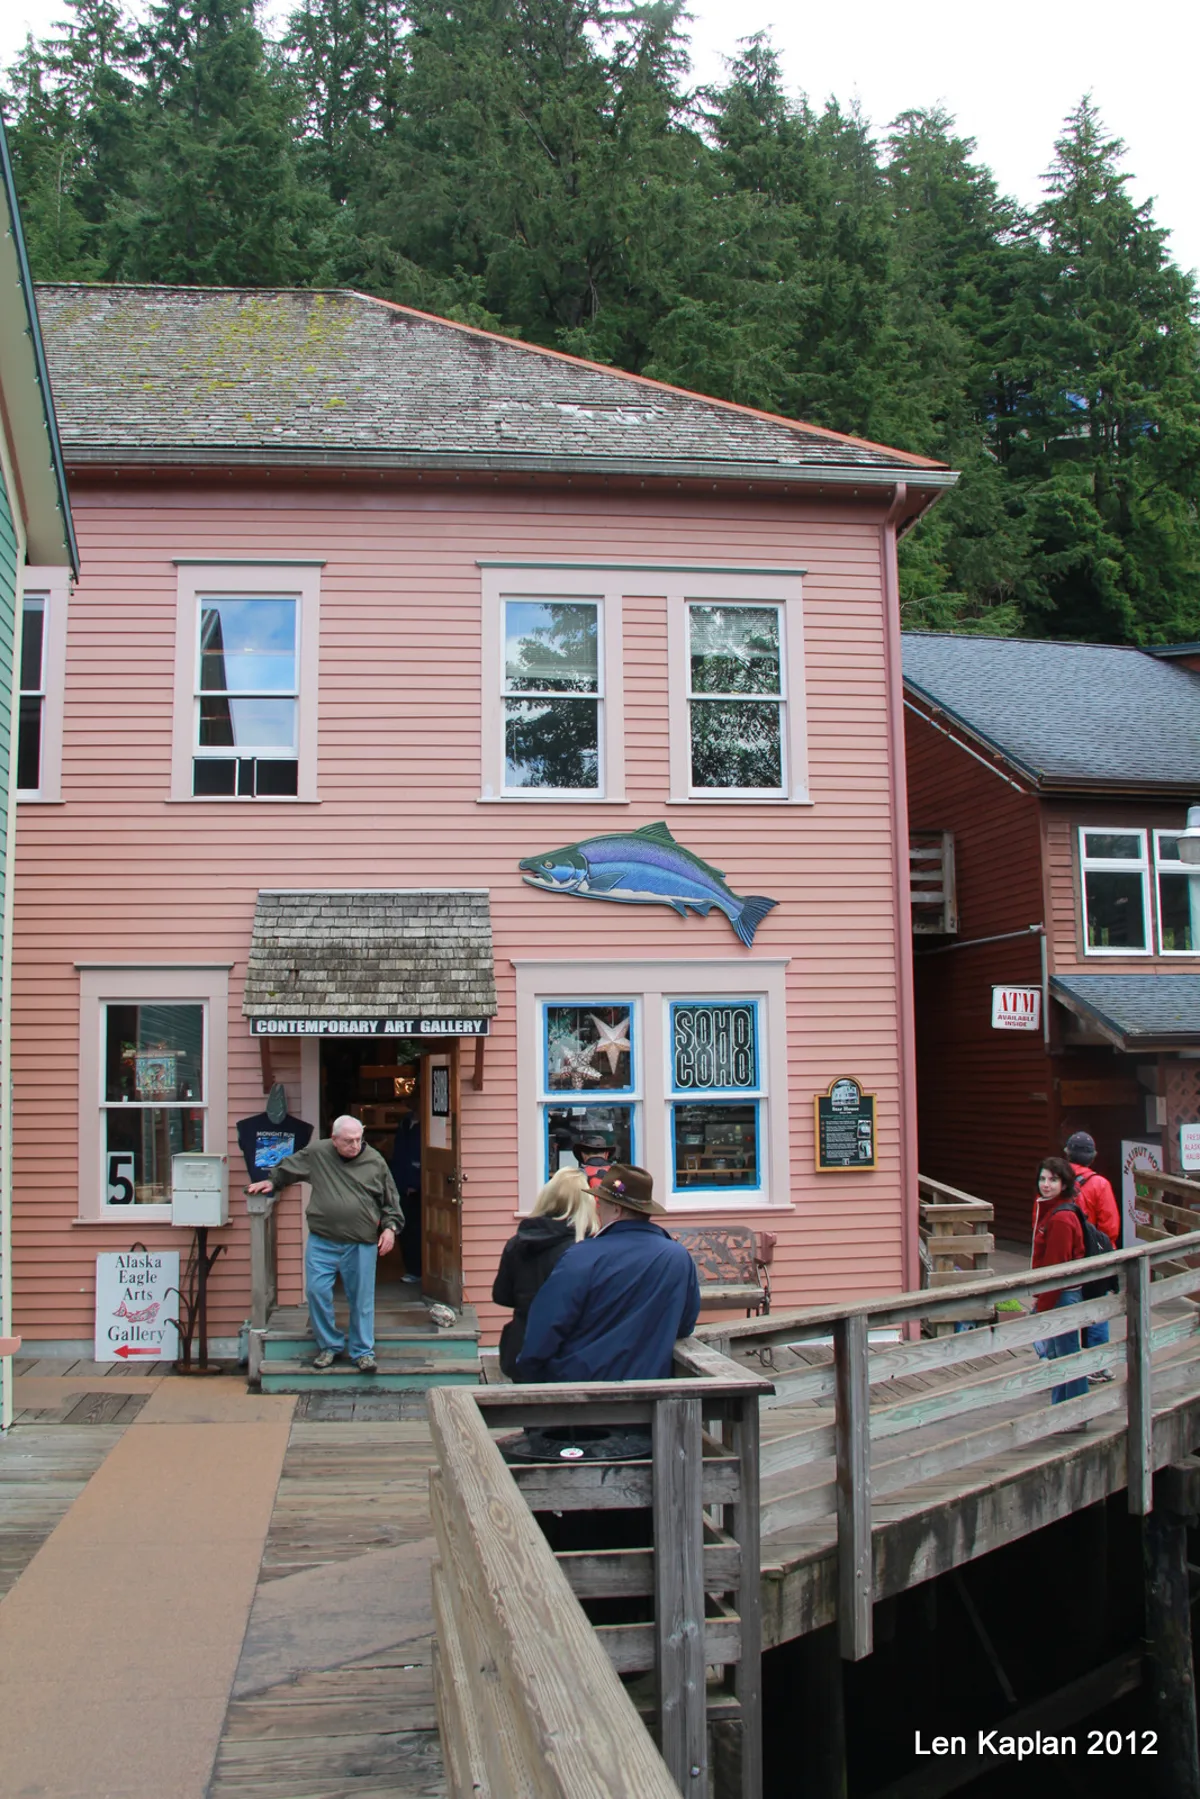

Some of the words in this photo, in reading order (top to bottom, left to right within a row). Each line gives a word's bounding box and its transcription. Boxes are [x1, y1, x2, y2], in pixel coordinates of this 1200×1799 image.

[999, 992, 1035, 1013] ATM
[256, 1020, 379, 1033] CONTEMPORARY
[384, 1020, 414, 1033] ART
[420, 1020, 482, 1033] GALLERY
[997, 1014, 1034, 1022] AVAILABLE
[675, 1009, 750, 1049] SOHO
[675, 1048, 752, 1088] COHO
[1123, 1145, 1148, 1175] HALIBUT
[108, 1156, 134, 1204] 5
[115, 1255, 162, 1268] Alaska
[118, 1270, 158, 1286] Eagle
[123, 1287, 153, 1301] Arts
[108, 1325, 166, 1344] Gallery
